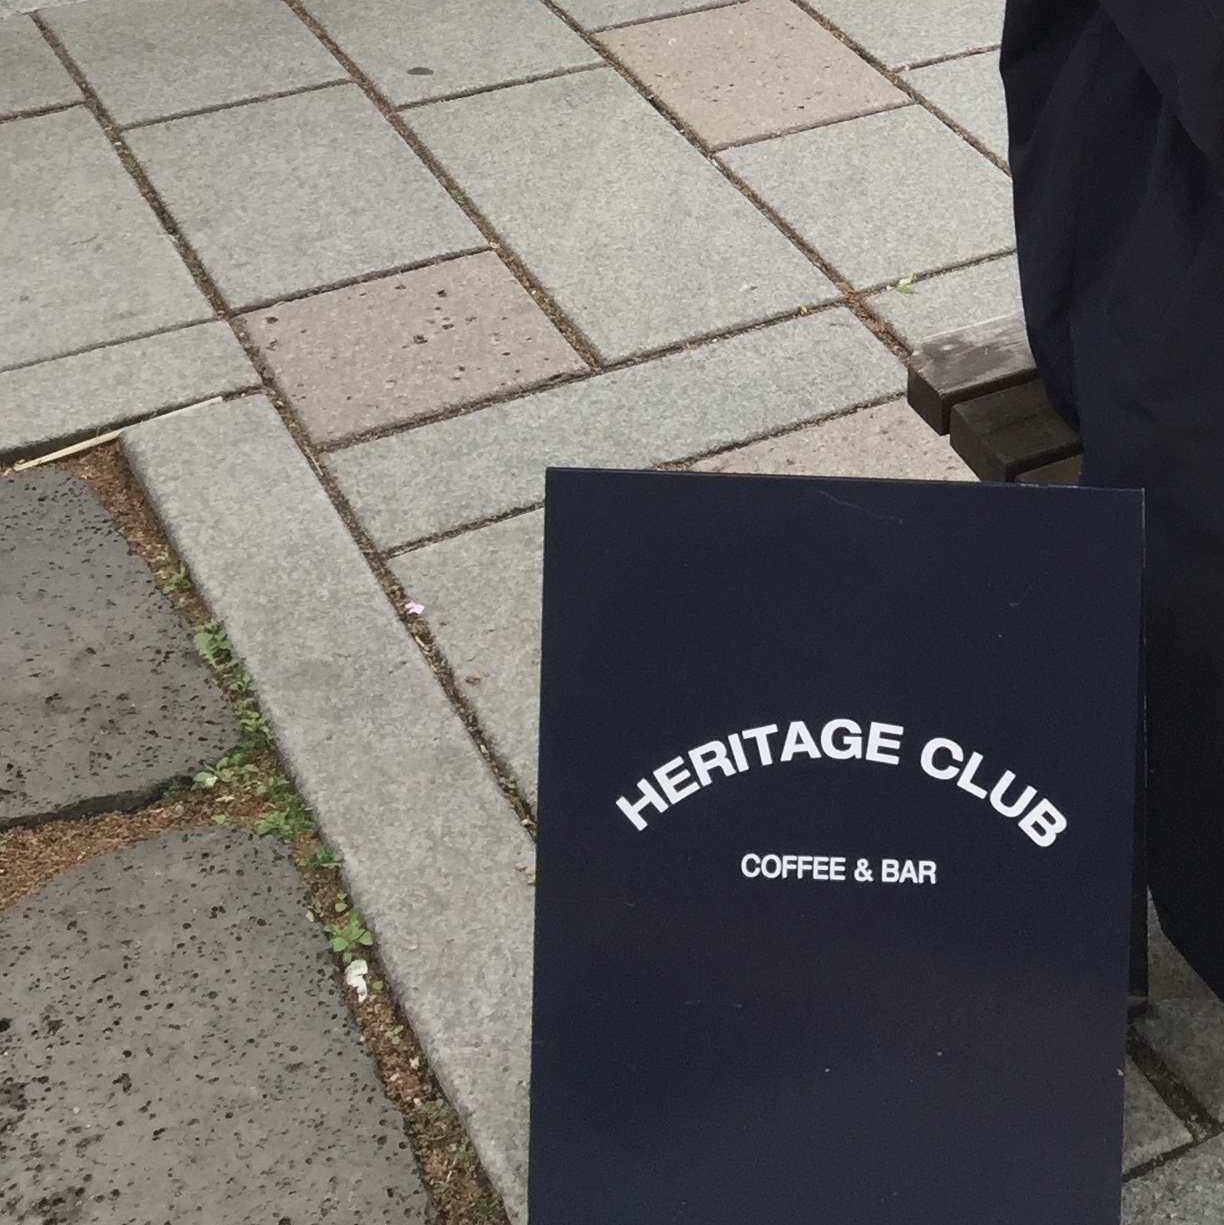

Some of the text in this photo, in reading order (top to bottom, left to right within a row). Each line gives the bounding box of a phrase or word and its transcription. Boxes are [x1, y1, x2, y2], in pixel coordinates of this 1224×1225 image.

[615, 718, 1068, 848] HERITAGE CLUB
[740, 853, 937, 885] COFFEE & BAR
